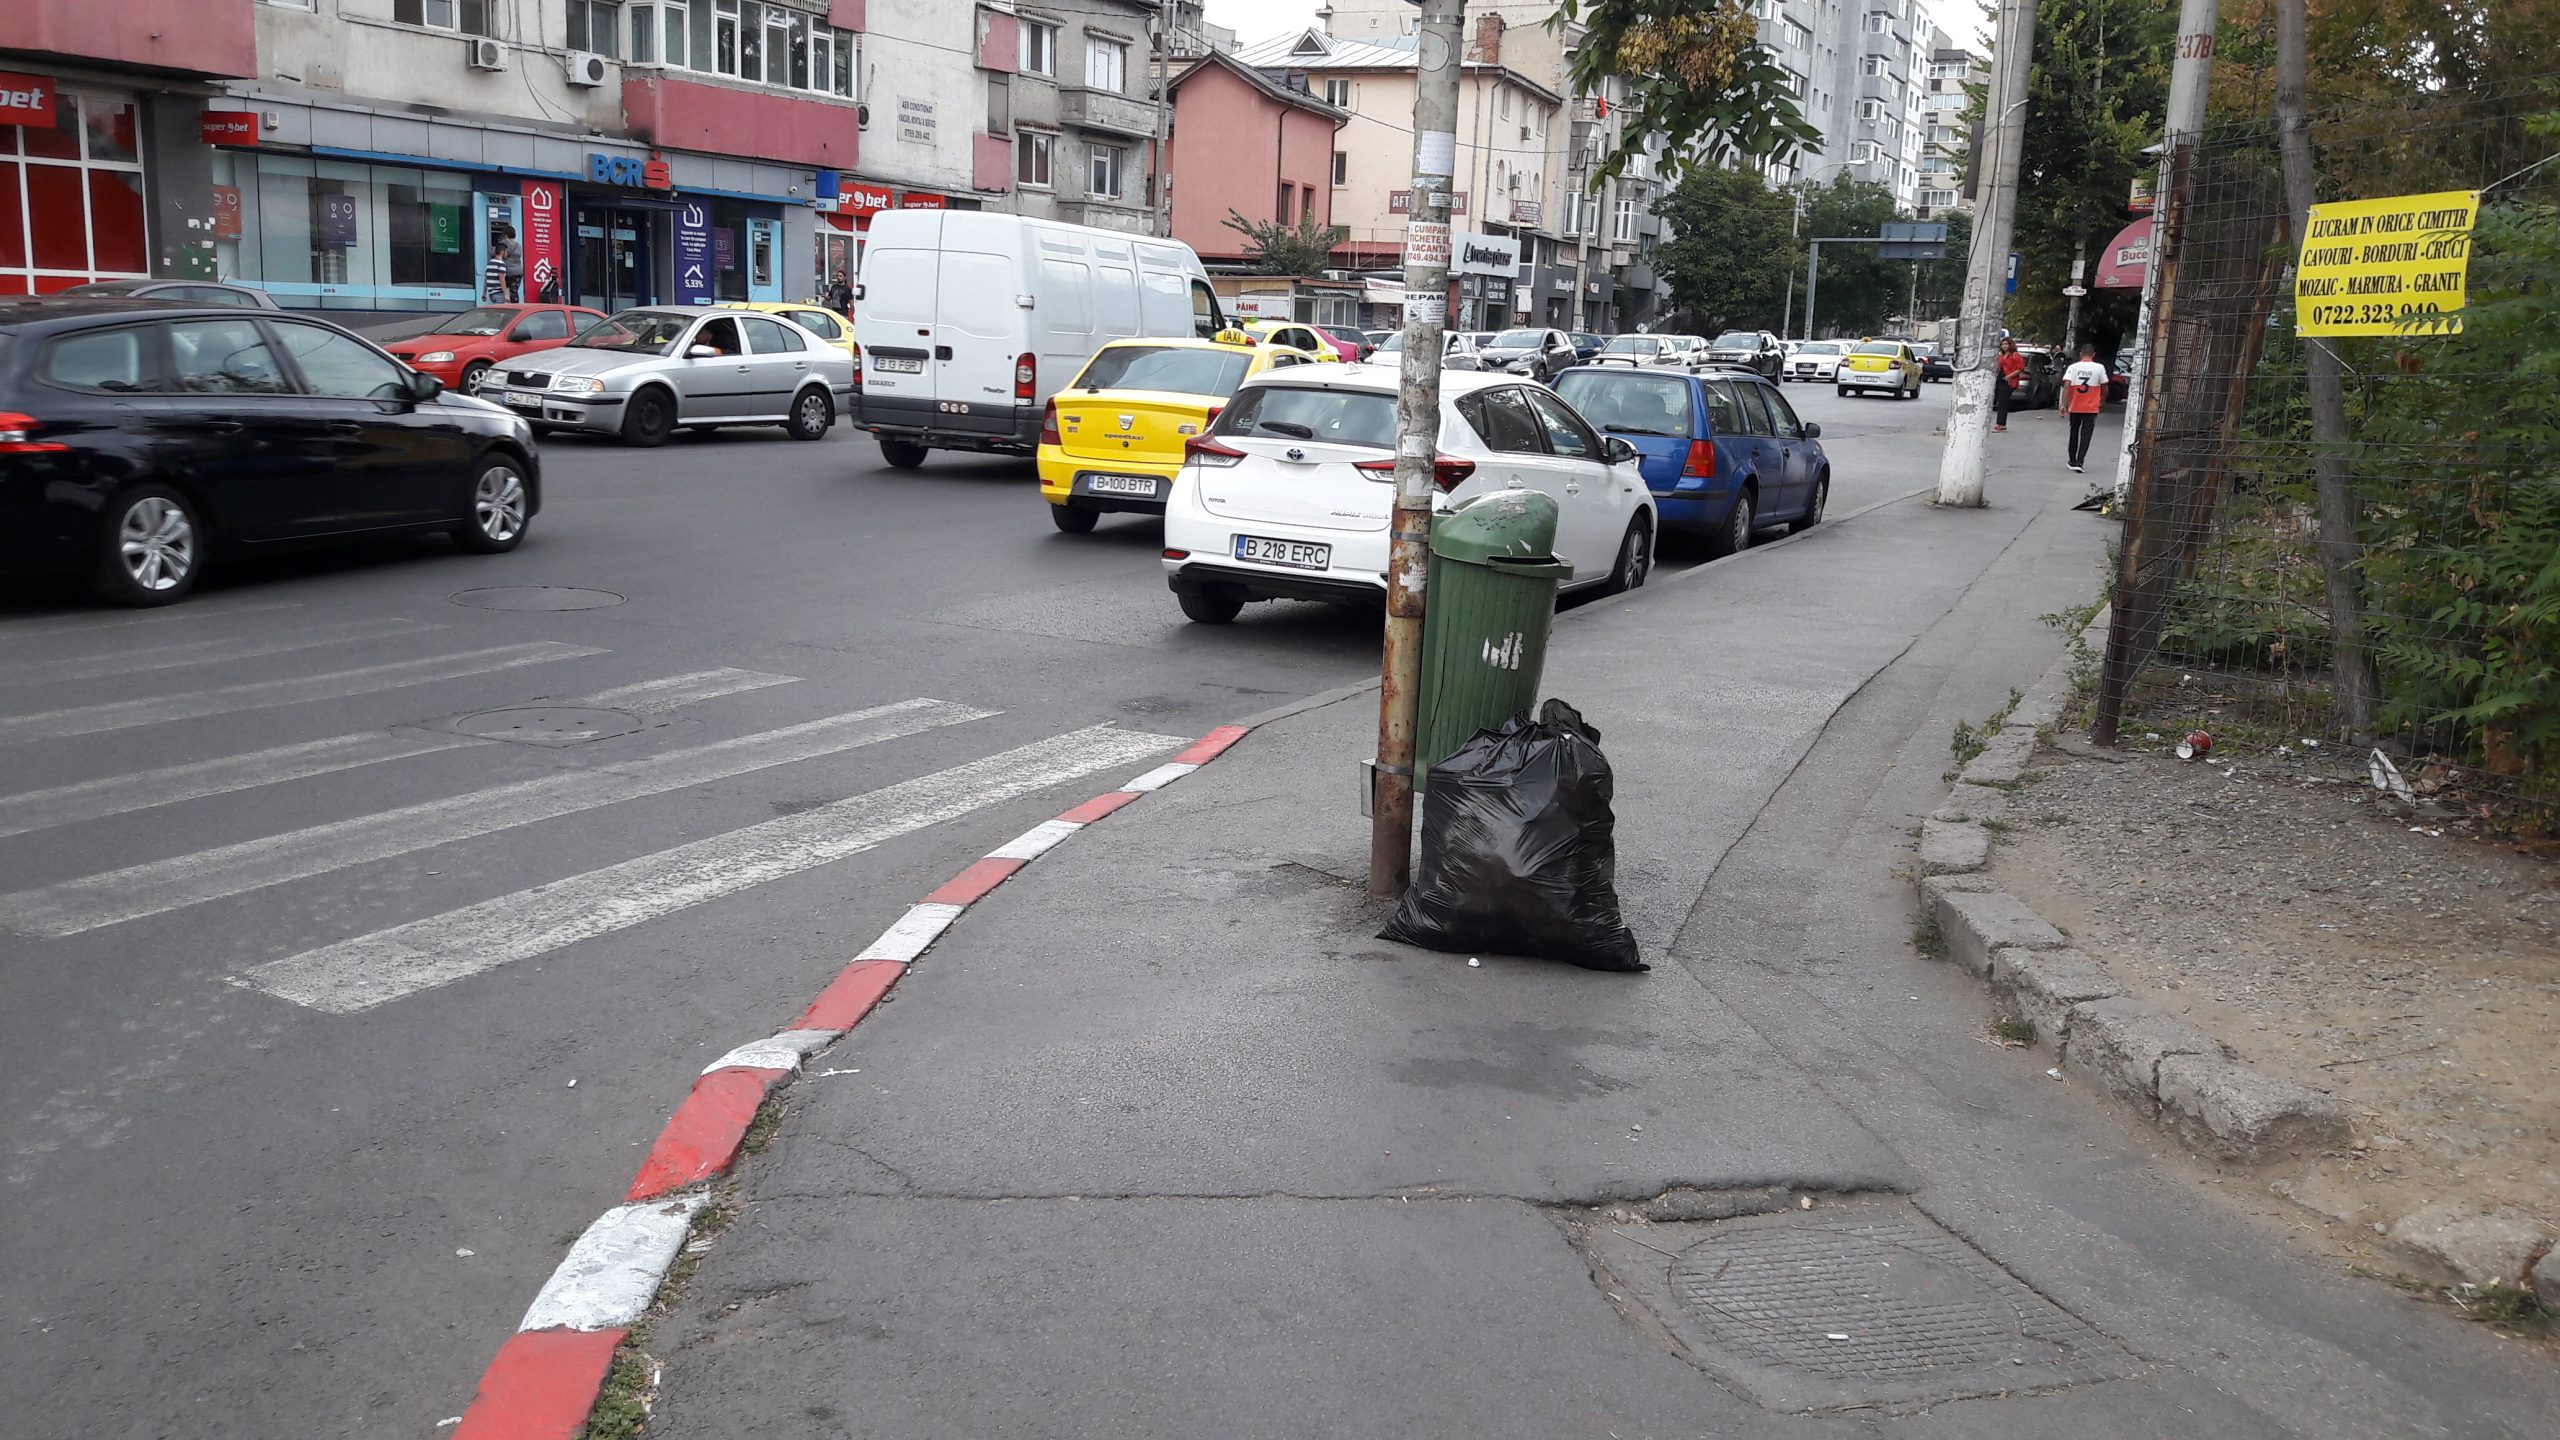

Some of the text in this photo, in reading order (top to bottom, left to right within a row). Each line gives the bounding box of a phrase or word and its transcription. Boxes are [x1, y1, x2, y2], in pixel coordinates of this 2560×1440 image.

[588, 153, 644, 189] BCR
[865, 193, 888, 209] bet
[1392, 195, 1411, 209] AFT
[1414, 225, 1447, 235] CUMPAR
[2312, 208, 2468, 238] LUCRAM IN ORICE CIMITIR
[1411, 243, 1447, 254] VACANTA
[2121, 250, 2149, 262] Buce
[2303, 247, 2354, 267] CAVOURI
[2361, 242, 2419, 264] BORDURI
[2298, 277, 2339, 297] MOZAIC
[2346, 274, 2403, 295] MARMURA
[2414, 271, 2461, 293] GRANIT
[1223, 330, 1240, 342] TAXI
[2077, 376, 2091, 394] 3
[1128, 479, 1154, 493] BTR
[1245, 539, 1326, 564] B 218 ERC
